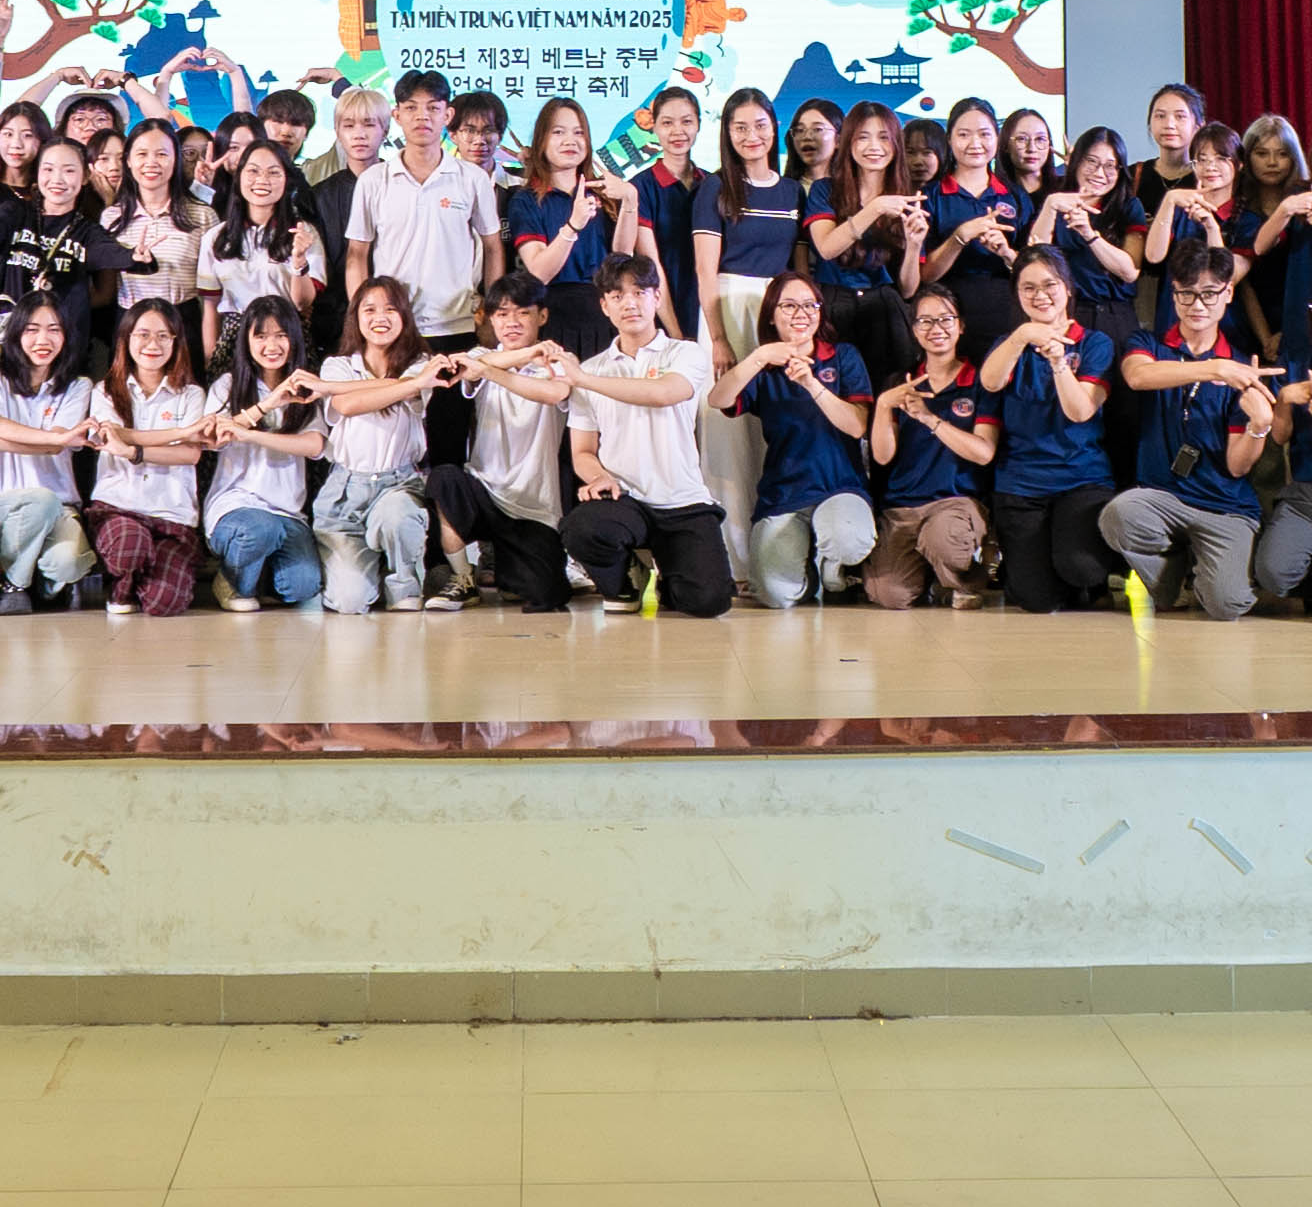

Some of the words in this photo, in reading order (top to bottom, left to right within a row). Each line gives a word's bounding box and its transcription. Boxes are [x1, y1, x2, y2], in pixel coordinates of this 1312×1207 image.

[390, 10, 415, 32] TẠI
[419, 5, 456, 29] MIỀN
[459, 10, 514, 29] TRUNG
[517, 7, 552, 32] VIỆT
[554, 10, 589, 29] NAM
[591, 7, 626, 29] NĂM
[629, 10, 672, 29] 2025
[400, 47, 466, 70] 2025년
[477, 47, 530, 70] 제3회
[542, 47, 607, 69] 베트남
[616, 47, 659, 70] 중부
[505, 76, 525, 98] 및
[535, 76, 578, 98] 문화
[587, 76, 629, 98] 축제
